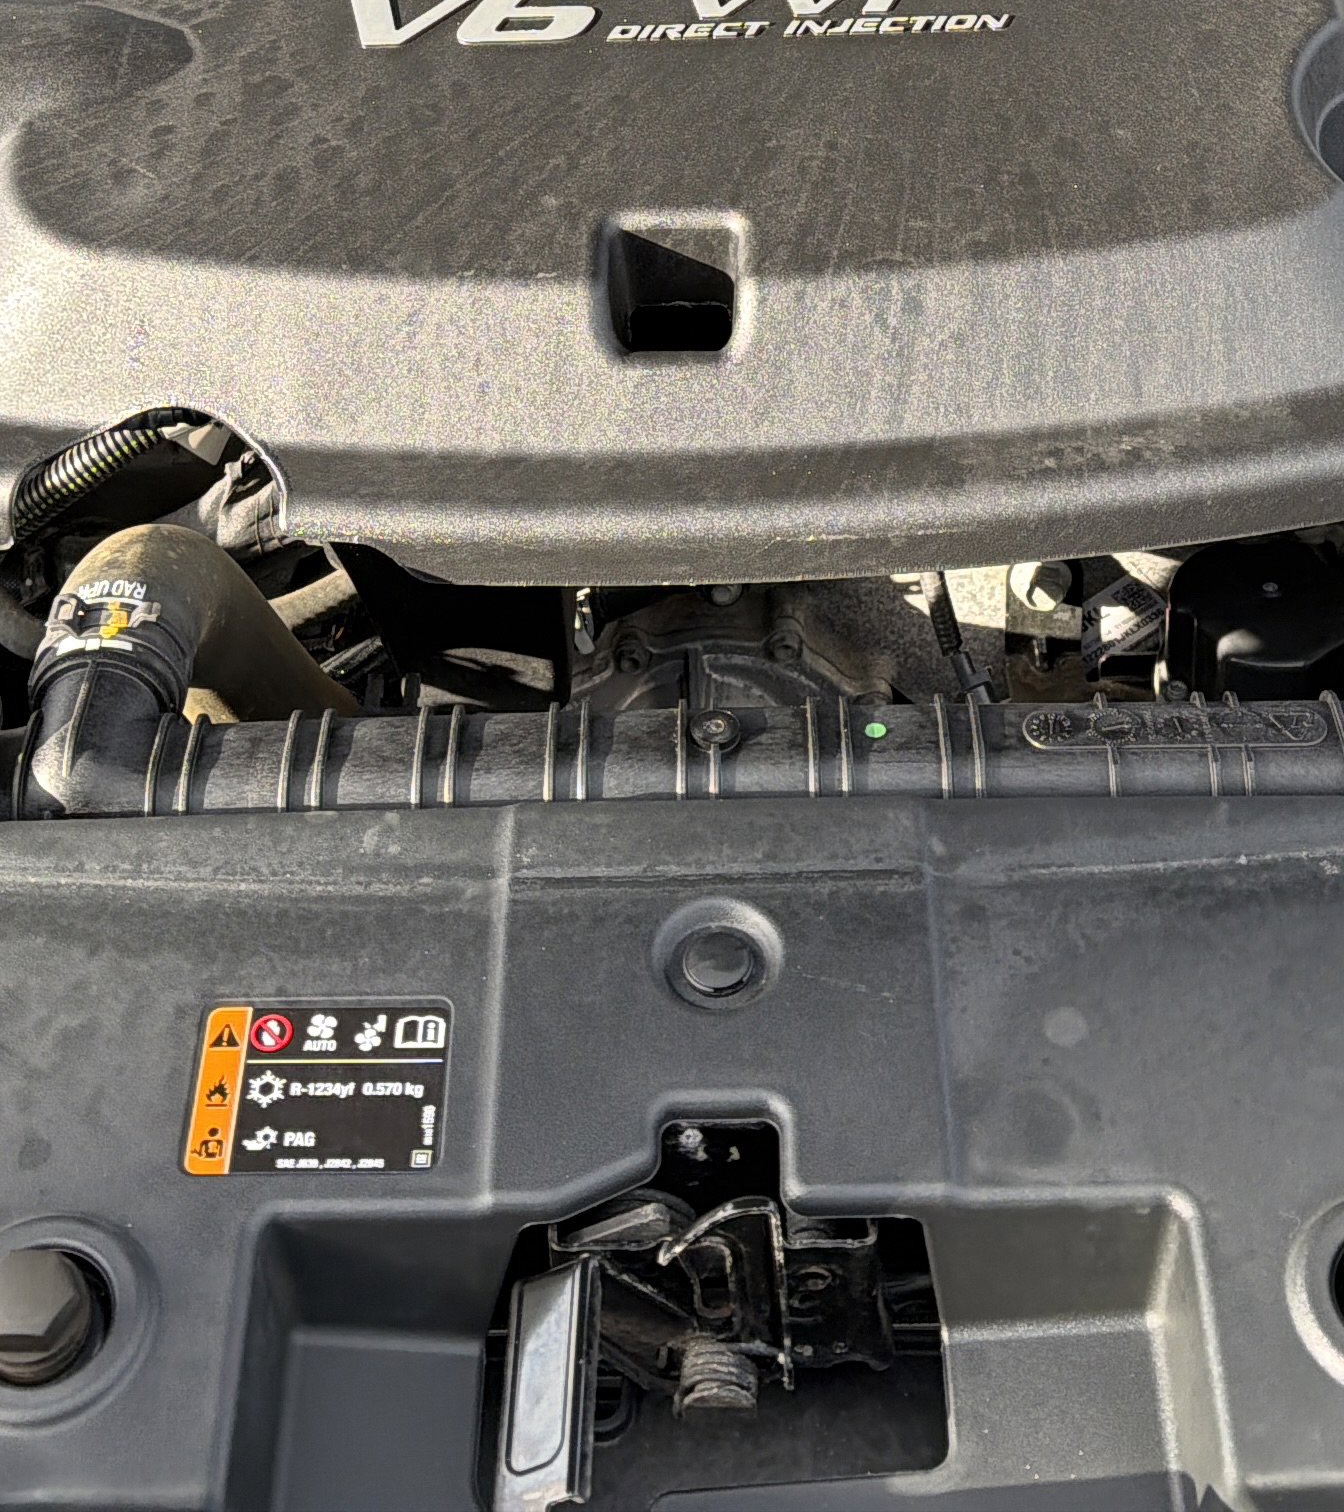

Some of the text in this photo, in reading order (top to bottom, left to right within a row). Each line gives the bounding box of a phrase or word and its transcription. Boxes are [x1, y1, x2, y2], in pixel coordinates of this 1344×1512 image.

[605, 13, 1016, 43] DIRECT INJECTION
[112, 580, 147, 600] RAD
[302, 1039, 337, 1052] AUTO
[289, 1082, 424, 1099] R-1234yf 0.570 kg
[282, 1132, 316, 1148] PAG
